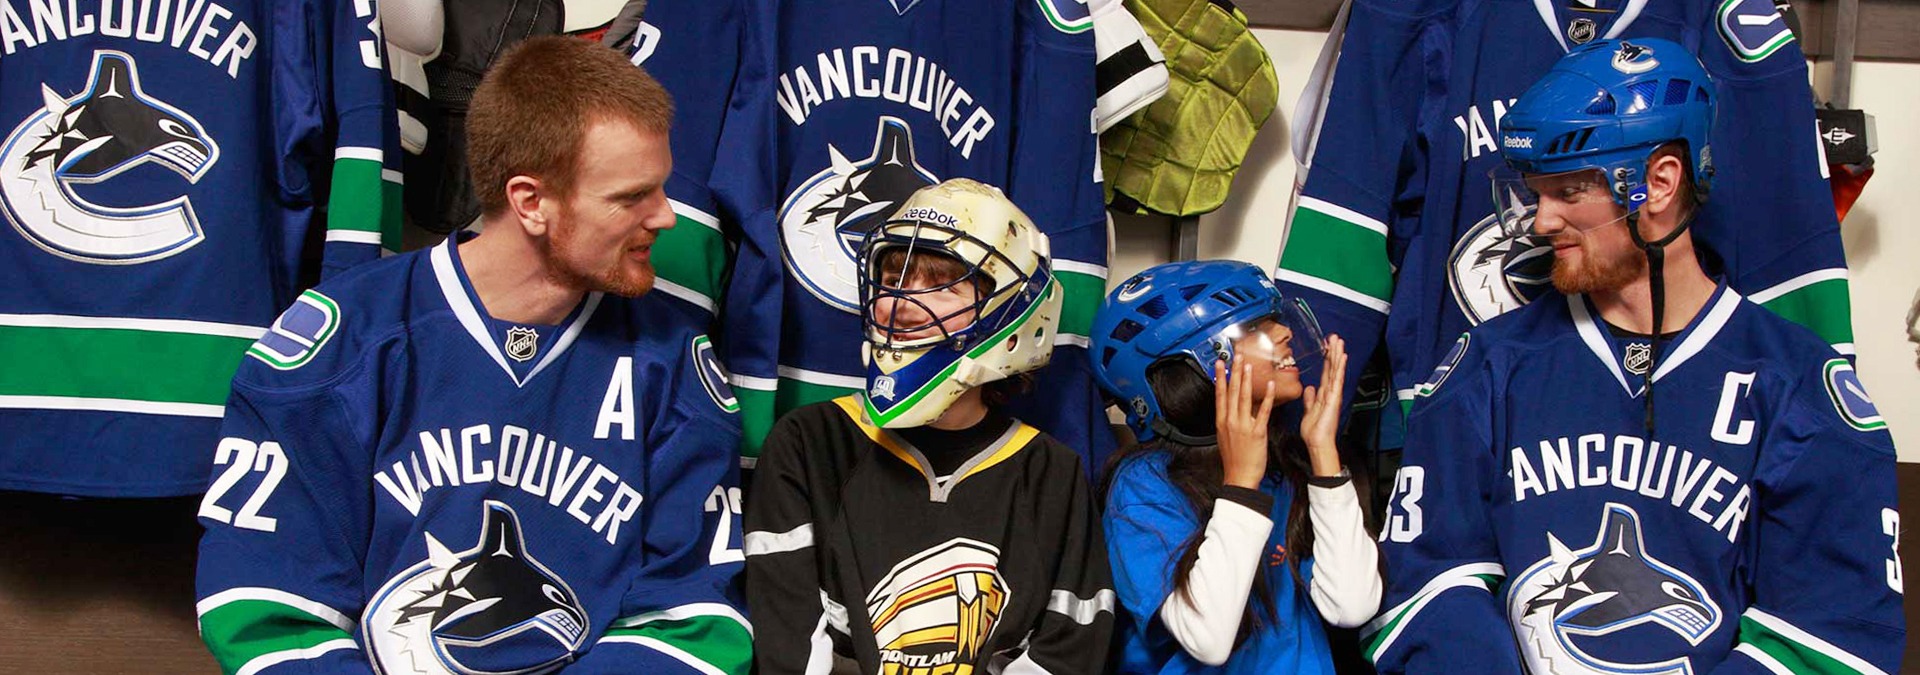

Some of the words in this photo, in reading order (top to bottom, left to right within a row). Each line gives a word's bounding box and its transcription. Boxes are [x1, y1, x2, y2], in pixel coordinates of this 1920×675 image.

[0, 0, 257, 79] ANCOUVER
[777, 46, 995, 160] VANCOUVER
[1504, 136, 1533, 148] Reebok
[513, 337, 531, 353] NHL
[1630, 351, 1649, 367] NHL
[593, 356, 635, 440] A
[1711, 371, 1756, 445] C
[195, 437, 289, 532] 22
[1378, 466, 1425, 543] 3
[1507, 433, 1750, 543] ANCOUVER
